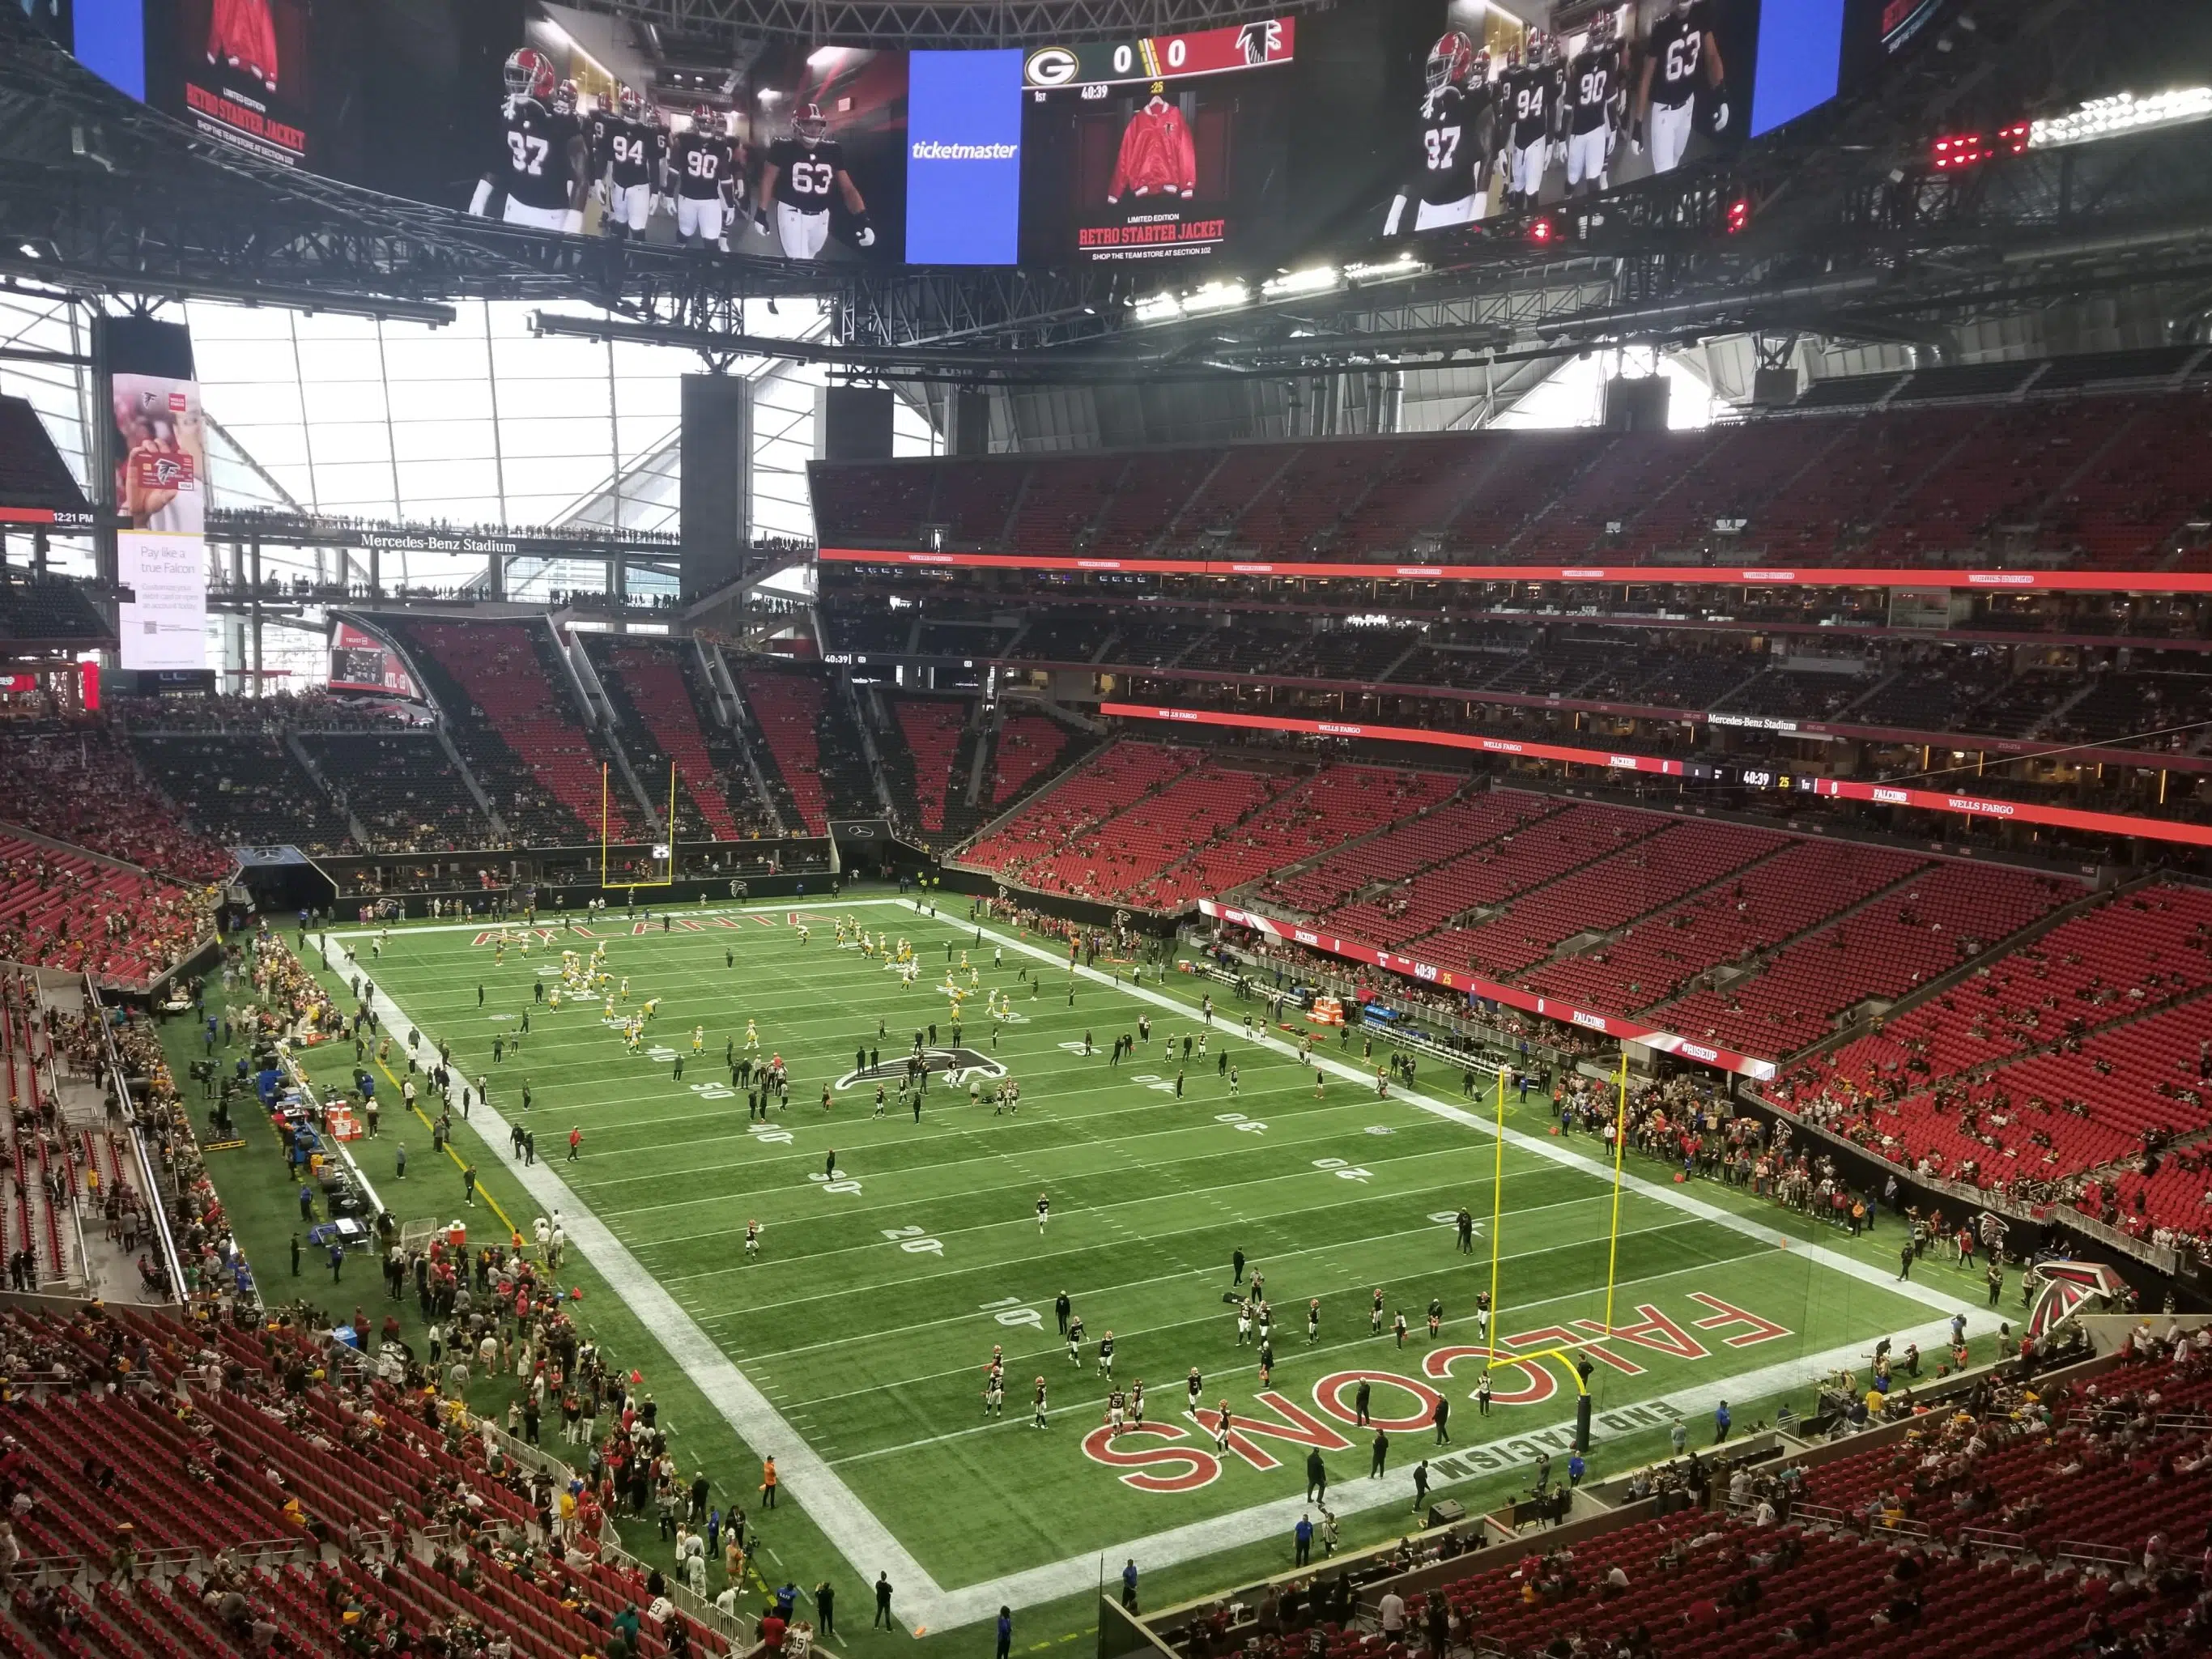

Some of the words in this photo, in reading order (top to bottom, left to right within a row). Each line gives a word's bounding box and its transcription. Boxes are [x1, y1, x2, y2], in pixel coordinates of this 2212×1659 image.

[1114, 45, 1132, 73] 0
[1168, 40, 1185, 66] 0
[1666, 31, 1701, 81] 63
[1081, 84, 1108, 99] 40:39
[1151, 82, 1163, 94] :25
[1580, 70, 1607, 104] 90
[1035, 91, 1046, 102] 1ST
[1517, 86, 1543, 119] 94
[243, 96, 266, 113] EDITION
[219, 99, 263, 135] STARTER
[264, 119, 305, 151] JACKET
[613, 136, 642, 164] 94
[912, 141, 1018, 159] ticketmaster
[687, 151, 718, 179] 90
[792, 162, 832, 194] 63
[1128, 215, 1153, 223] LIMITED
[1154, 214, 1179, 222] EDITION
[1079, 228, 1120, 245] RETRO
[1121, 224, 1176, 245] STARTER
[1178, 219, 1224, 240] JACKET
[1092, 252, 1110, 260] SHOP
[1143, 250, 1163, 258] STORE
[1173, 248, 1200, 257] SECTION
[53, 513, 76, 522] 12:21
[79, 513, 93, 523] PM
[361, 534, 460, 550] Mercedes-Benz
[463, 538, 516, 553] Stadium
[141, 546, 159, 560] Pay
[162, 547, 177, 557] like
[180, 550, 185, 559] a
[141, 564, 161, 573] true
[164, 563, 194, 573] Falcon
[825, 655, 848, 664] 40:39
[385, 673, 397, 688] ATL
[1318, 724, 1338, 732] WELLS
[1340, 725, 1360, 734] FARGO
[1708, 714, 1763, 728] Mercedes-Benz
[1764, 719, 1797, 730] Stadium
[1483, 741, 1502, 750] WELLS
[1503, 742, 1521, 751] FARGO
[1610, 756, 1636, 766] PACKERS
[1662, 761, 1668, 772] 0
[1743, 771, 1769, 785] 40:39
[1779, 776, 1789, 788] 25
[1802, 779, 1810, 790] 1ST
[1831, 782, 1837, 793] 0
[1874, 789, 1907, 802] FALCONS
[1949, 799, 1980, 810] WELLS
[1982, 803, 2014, 815] FARGO
[470, 911, 839, 946] ATLANTA
[1295, 930, 1317, 943] PACKERS
[1335, 939, 1339, 951] 0
[1414, 963, 1436, 980] 40:39
[1443, 973, 1452, 985] 25
[1538, 999, 1544, 1012] 0
[1574, 1010, 1606, 1029] FALCONS
[646, 1048, 686, 1062] 40
[1057, 1041, 1103, 1056] 50
[1682, 1043, 1717, 1061] #RISEUP
[1130, 1074, 1176, 1091] 40
[690, 1082, 735, 1100] 50
[1214, 1112, 1269, 1133] 30
[747, 1124, 794, 1142] 40
[1312, 1157, 1375, 1180] 20
[807, 1169, 863, 1193] 30
[880, 1225, 944, 1253] 20
[978, 1296, 1042, 1326] 10
[1081, 1291, 1795, 1493] FALCONS
[1112, 1399, 1123, 1409] 67
[1598, 1401, 1686, 1431] END
[1432, 1423, 1601, 1479] RACISM
[592, 1512, 597, 1520] 2
[649, 1602, 661, 1615] 23
[793, 1637, 805, 1649] 15
[1310, 1639, 1321, 1653] 15
